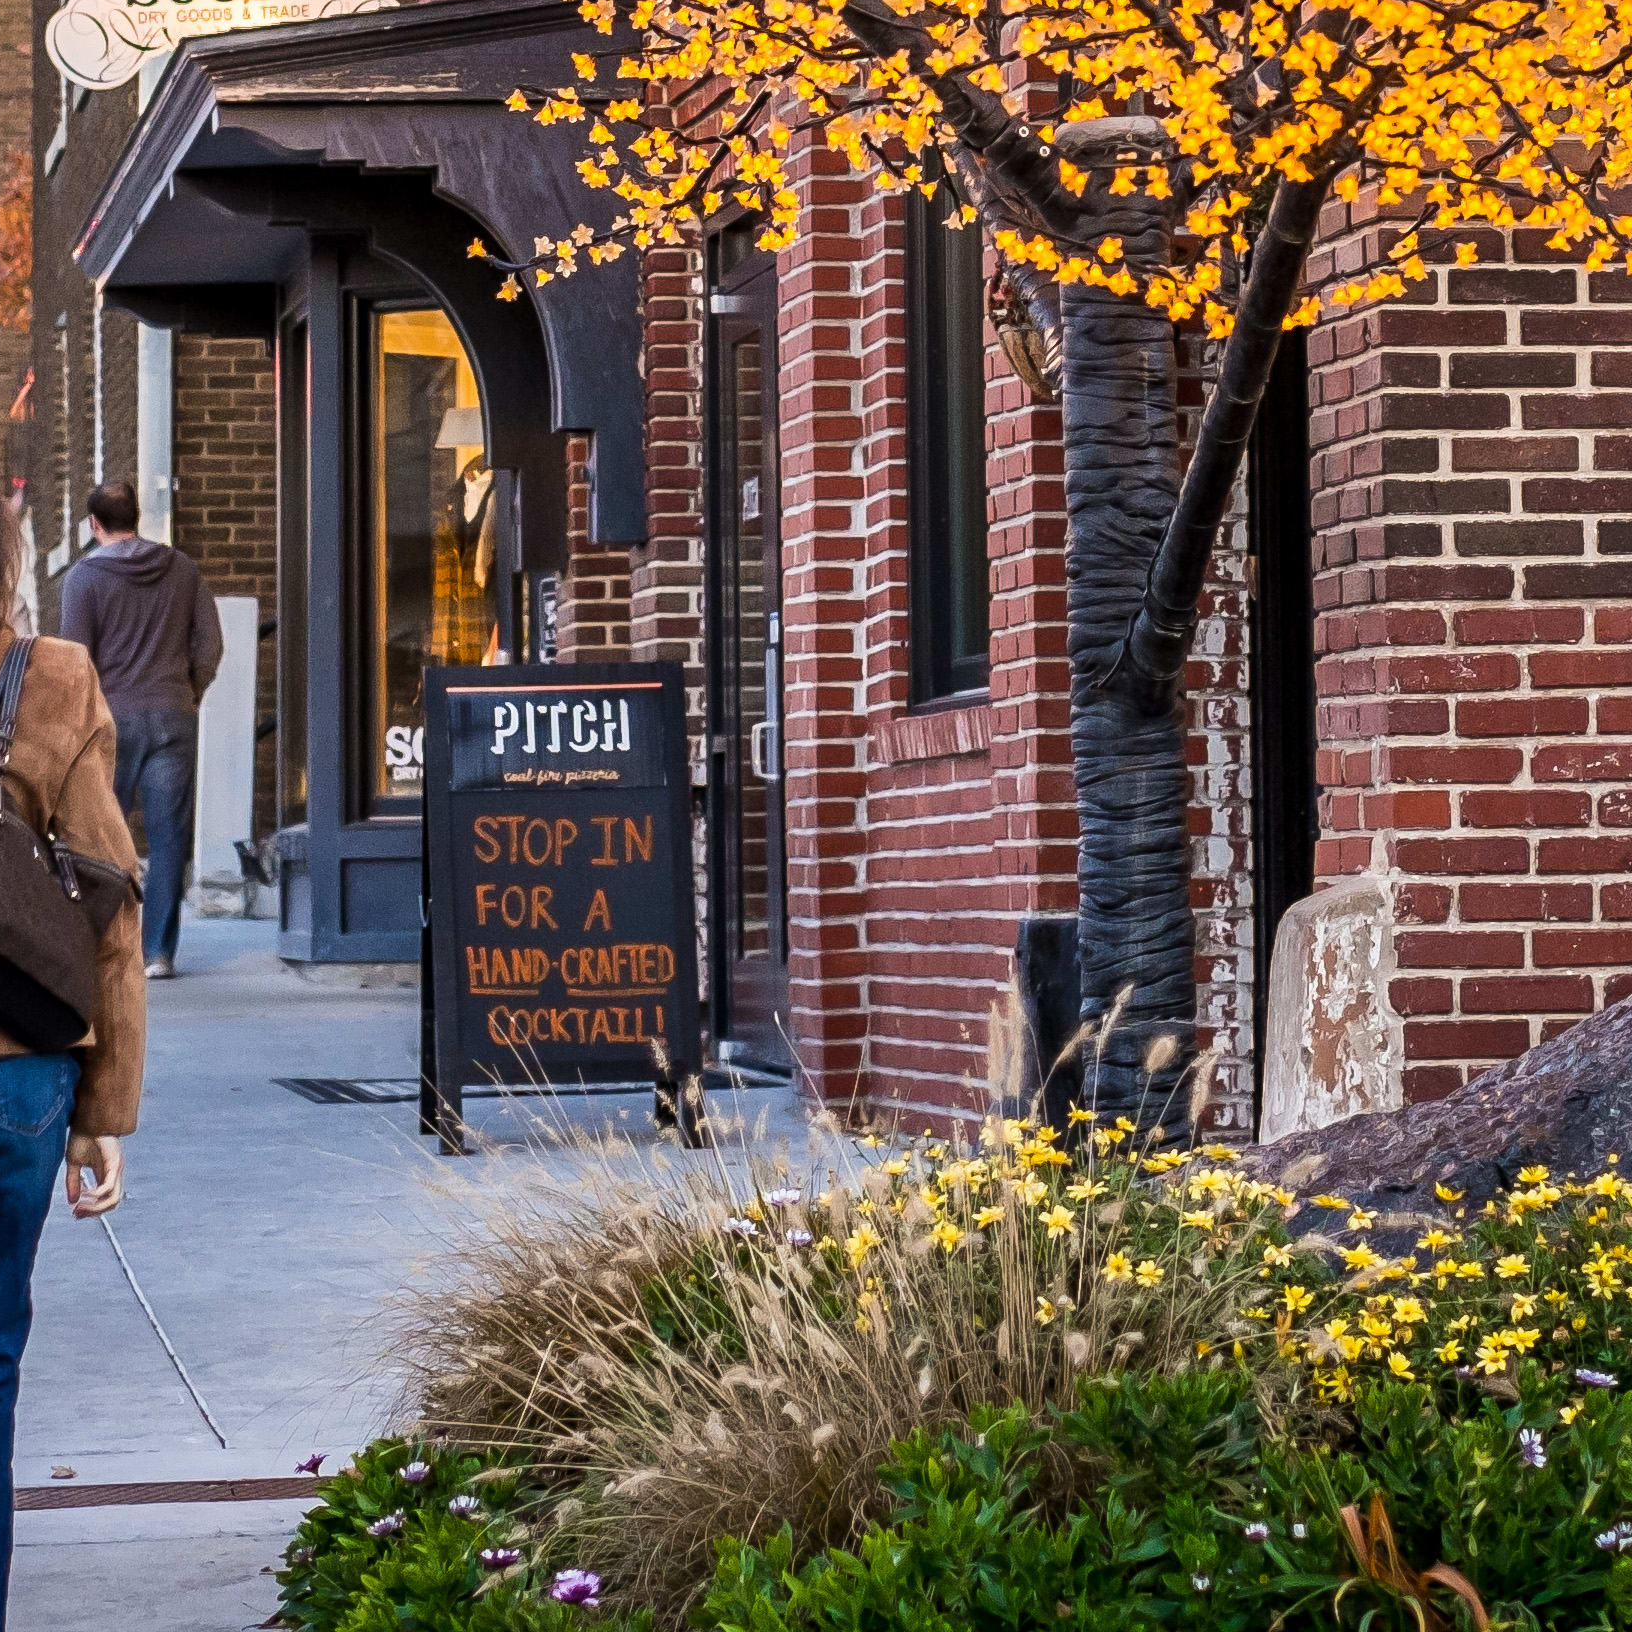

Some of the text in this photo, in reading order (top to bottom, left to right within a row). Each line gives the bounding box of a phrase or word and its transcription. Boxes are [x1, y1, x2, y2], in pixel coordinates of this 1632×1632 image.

[138, 10, 168, 25] DRY
[176, 6, 233, 23] GOODS
[260, 4, 311, 20] TRADE
[491, 699, 631, 755] PITCH
[473, 814, 655, 866] STOP IN
[475, 884, 613, 932] FOR A
[487, 1005, 666, 1046] COCKTAIL!
